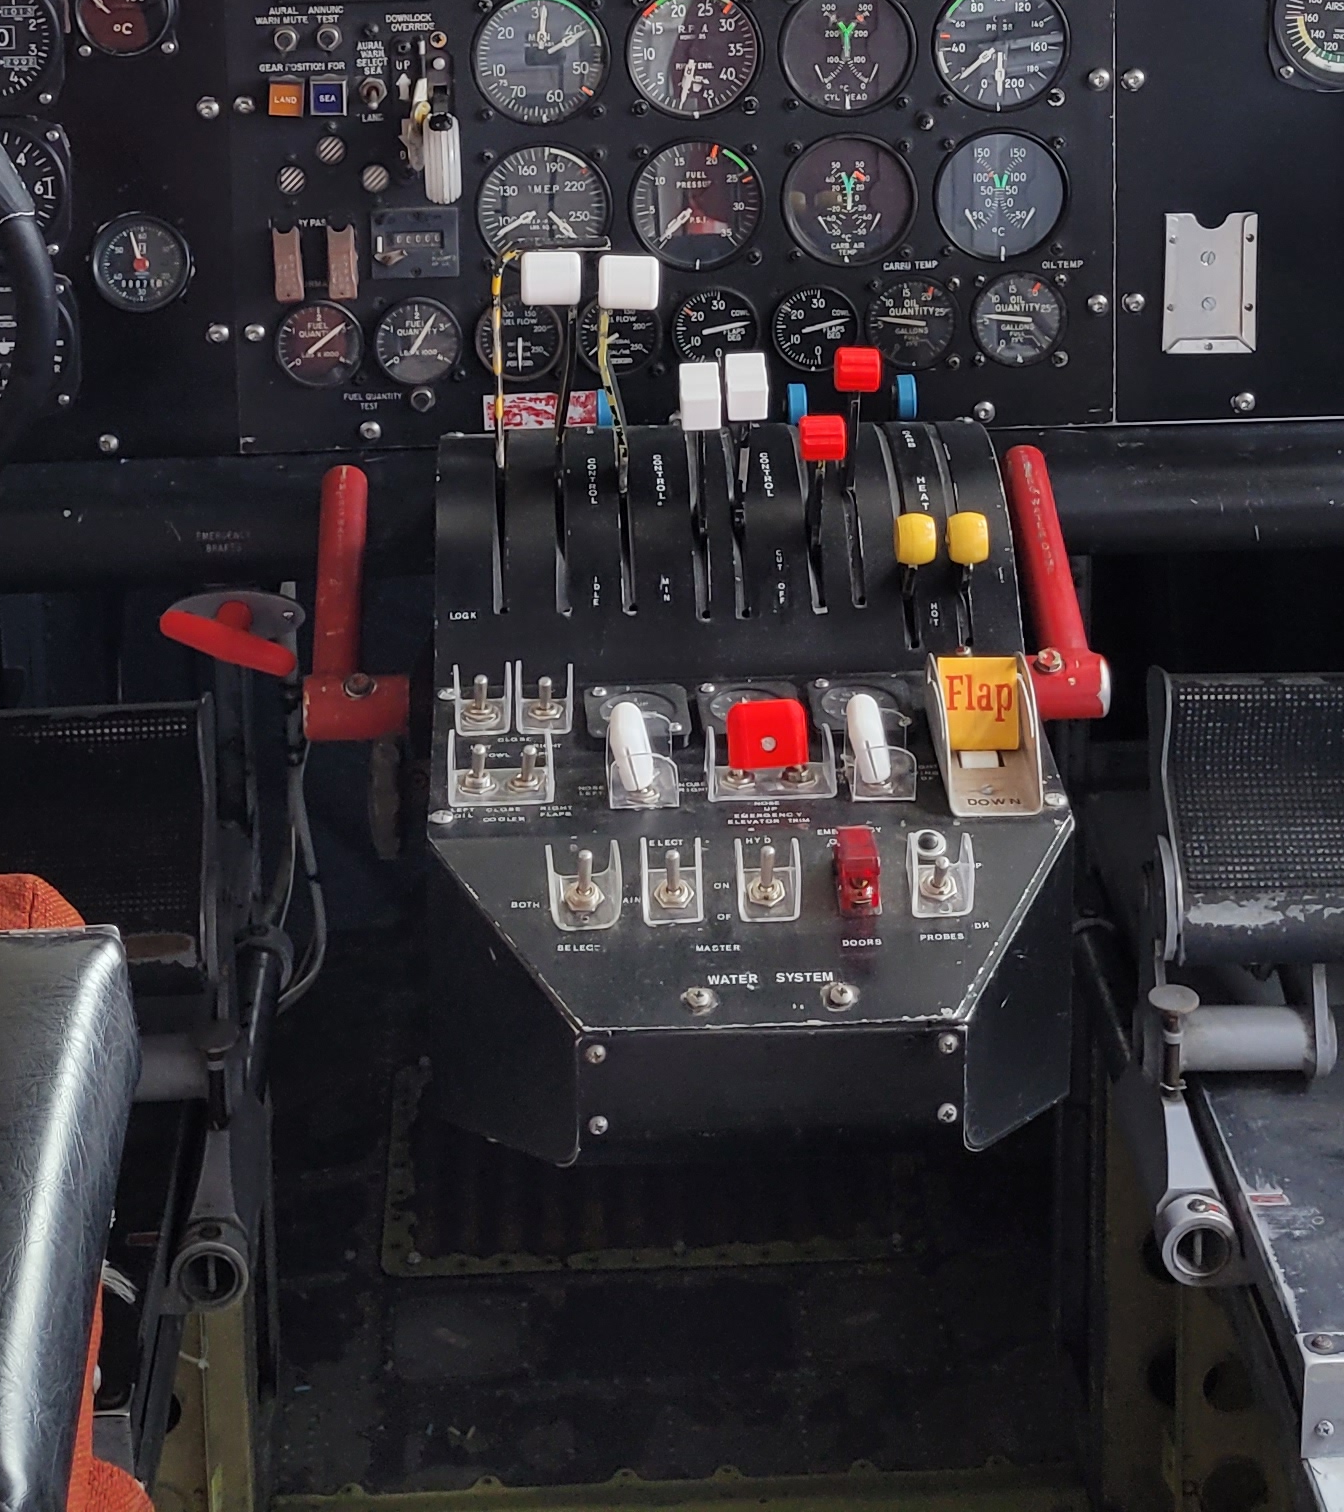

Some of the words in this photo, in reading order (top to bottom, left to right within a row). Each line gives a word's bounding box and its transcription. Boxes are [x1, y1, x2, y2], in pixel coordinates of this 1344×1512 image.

[269, 6, 298, 14] AURAL
[308, 6, 343, 14] ANNUNC
[698, 4, 714, 16] 25
[255, 17, 280, 25] WARN
[283, 16, 308, 24] MUTE
[317, 15, 339, 23] TEST
[386, 14, 432, 23] DOWNLOCK
[391, 22, 435, 31] OVERRIDE
[651, 23, 664, 34] 15
[357, 41, 384, 50] AURAL
[728, 44, 744, 56] 35
[1030, 42, 1048, 52] 160
[1323, 42, 1338, 51] 120
[361, 50, 385, 58] WARN
[259, 64, 283, 72] GEAR
[328, 62, 345, 70] FOR
[357, 58, 388, 67] SELECT
[396, 61, 410, 70] UP
[364, 66, 382, 75] SEA
[492, 64, 505, 76] 10
[719, 68, 736, 80] 40
[274, 96, 297, 104] LAND
[319, 95, 336, 103] SEA
[546, 90, 564, 102] 60
[824, 93, 840, 101] CYL
[1010, 148, 1026, 157] 150
[546, 162, 565, 173] 190
[686, 171, 707, 179] FUEL
[655, 177, 666, 185] 10
[499, 186, 518, 196] 130
[569, 211, 590, 221] 250
[915, 260, 938, 270] TEMP
[1042, 260, 1054, 269] OIL
[1055, 260, 1083, 269] TEMP
[904, 299, 919, 307] OIL
[1010, 295, 1025, 304] OIL
[889, 307, 934, 316] QUANTITY
[995, 303, 1040, 313] QUANTITY
[691, 312, 704, 322] 20
[791, 309, 804, 319] 20
[308, 322, 328, 330] FUEL
[1001, 323, 1034, 331] GALLONS
[343, 393, 363, 401] FUEL
[365, 392, 402, 401] QUANTITY
[653, 455, 666, 500] CONTROL
[759, 452, 774, 497] CONTROL
[587, 458, 597, 504] CONTROL
[917, 476, 930, 510] HEAT
[775, 549, 783, 571] CUT
[661, 578, 670, 602] MIN
[931, 603, 939, 626] HOT
[945, 674, 1013, 722] Flap
[968, 798, 1021, 806] DOWN
[920, 933, 964, 941] PROBES
[842, 938, 882, 946] DOORS
[707, 974, 758, 985] WATER
[775, 972, 833, 983] SYSTEM
